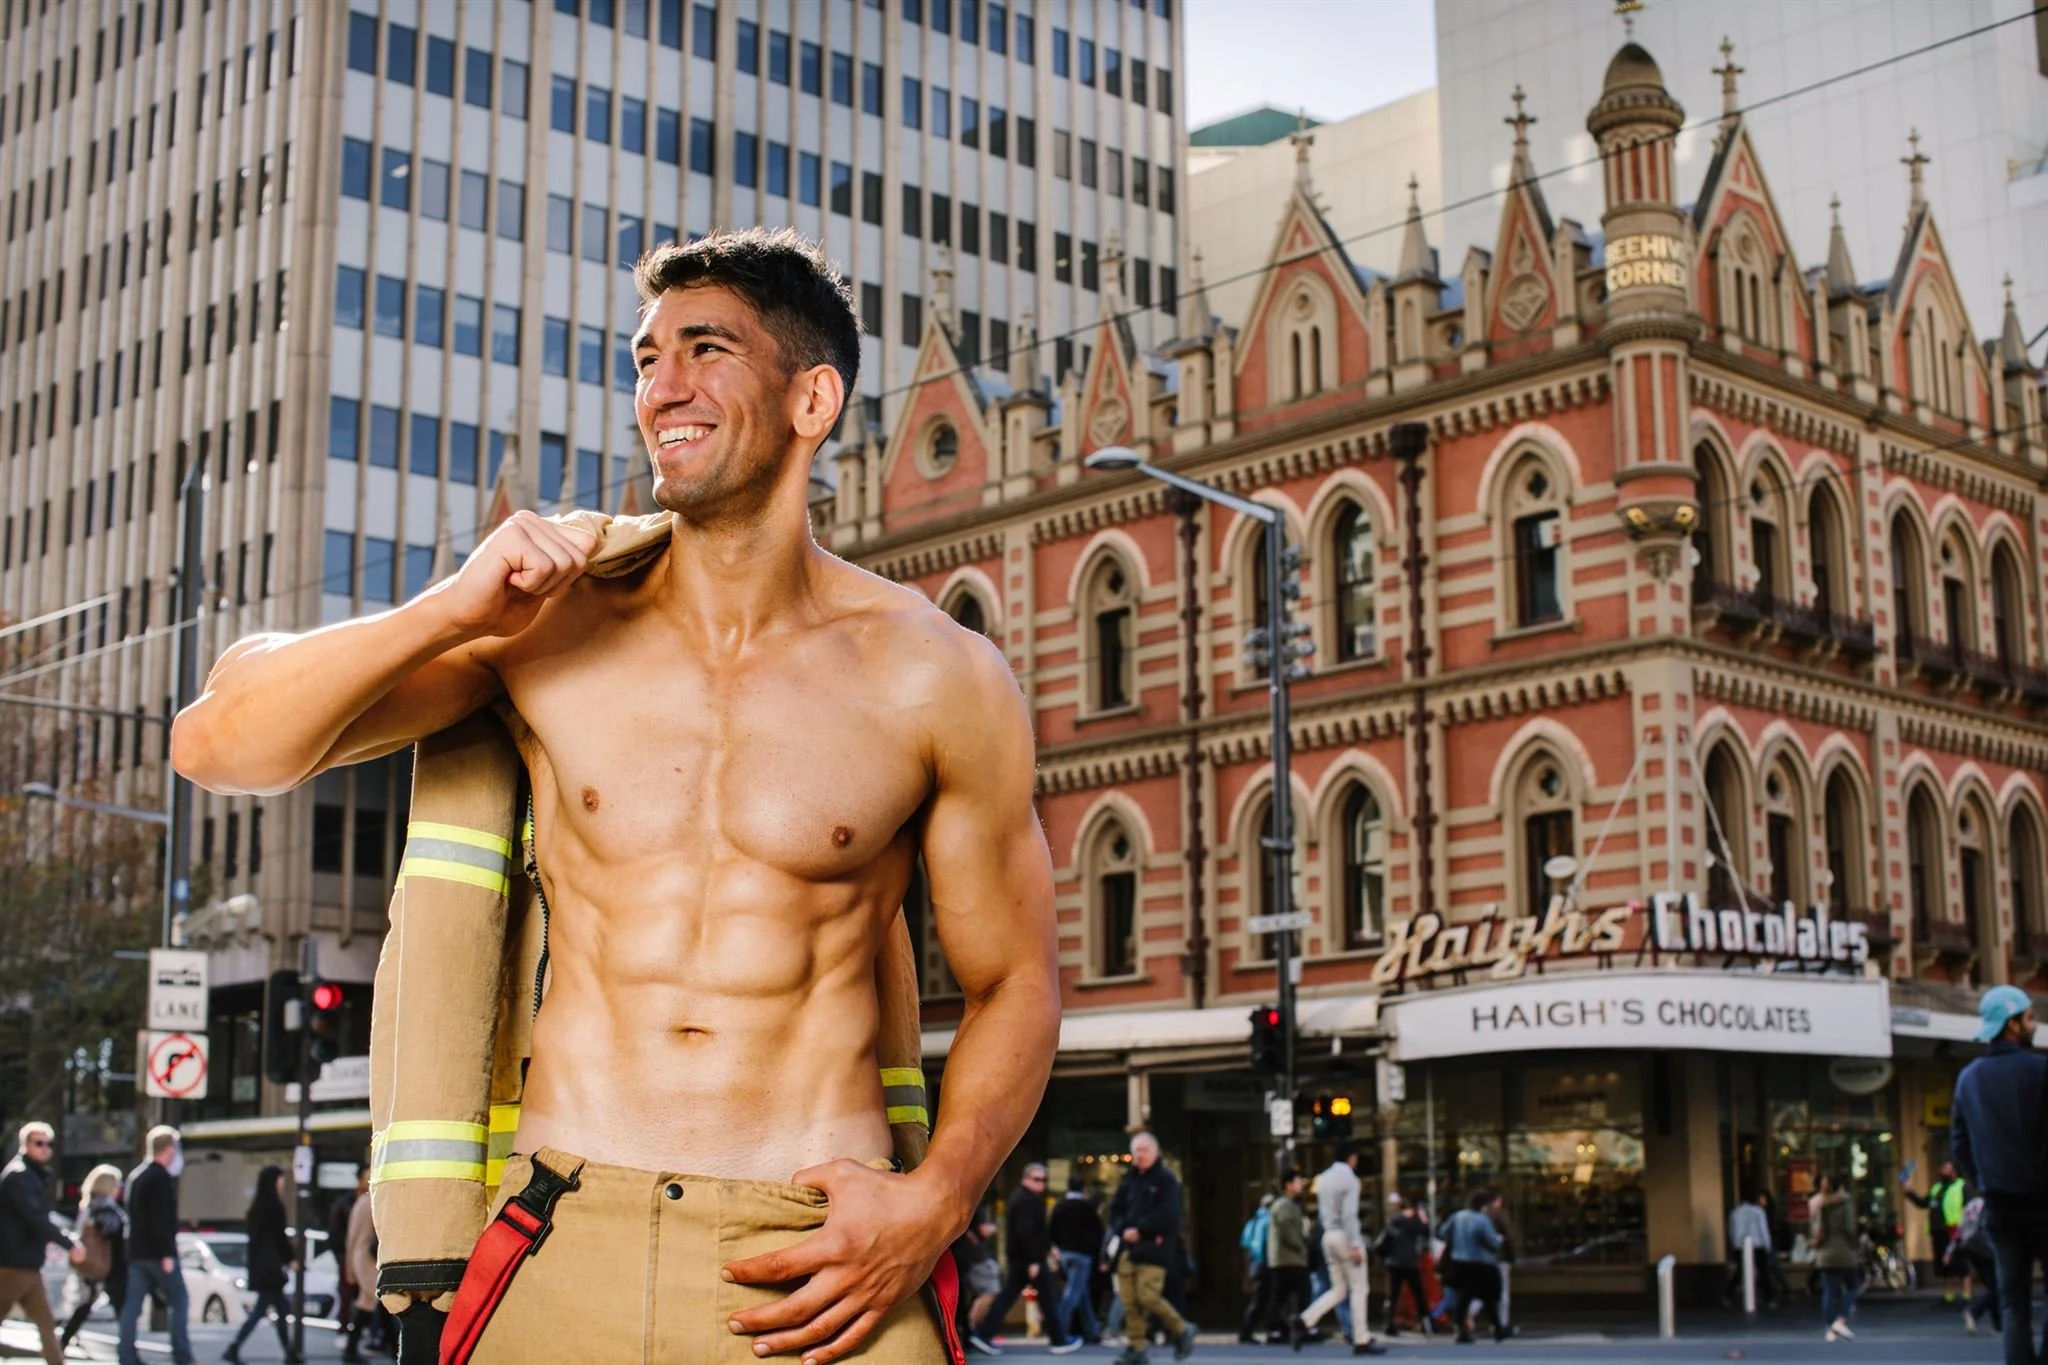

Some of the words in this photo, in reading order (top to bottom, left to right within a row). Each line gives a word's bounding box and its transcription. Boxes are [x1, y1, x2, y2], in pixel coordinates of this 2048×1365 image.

[1606, 260, 1686, 292] CORNE
[1651, 891, 1869, 963] Chocolates
[154, 999, 200, 1020] LANE
[1472, 1000, 1644, 1032] HAIGH'S
[1658, 1000, 1811, 1034] CHOCOLATES
